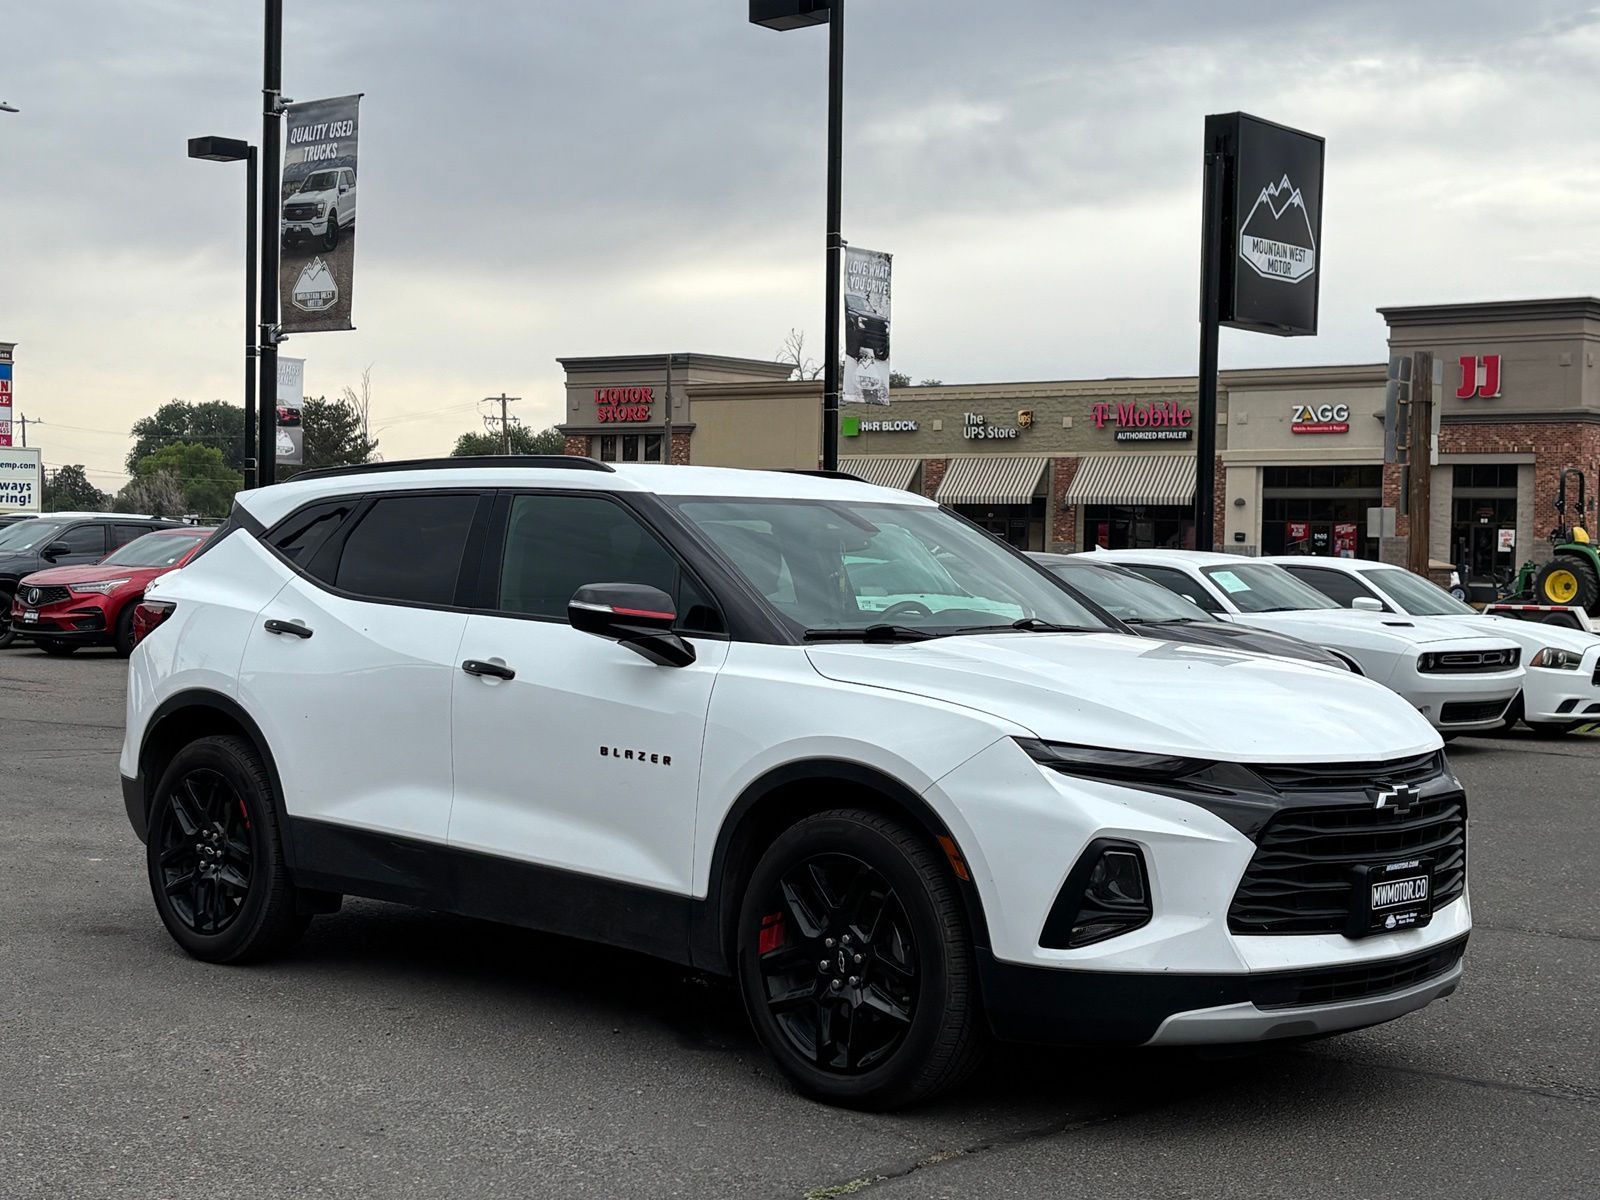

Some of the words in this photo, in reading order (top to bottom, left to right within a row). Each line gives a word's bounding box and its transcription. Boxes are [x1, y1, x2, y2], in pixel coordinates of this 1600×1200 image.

[291, 123, 328, 144] QUALITY
[329, 120, 353, 138] USED
[304, 142, 338, 162] TRUCKS
[1252, 238, 1288, 259] MOUNTAIN
[1289, 247, 1306, 263] WEST
[849, 261, 868, 275] LOVE
[870, 263, 888, 279] WHAT
[1268, 258, 1292, 275] MOTOR
[850, 275, 866, 290] YOU
[593, 386, 653, 406] LIQUOR
[597, 405, 649, 423] STORE
[963, 412, 984, 425] The
[1090, 401, 1192, 429] T-Mobile
[1292, 404, 1349, 422] ZAGG
[861, 421, 880, 431] H&R
[882, 420, 917, 431] BLOCK
[963, 426, 985, 439] UPS
[987, 426, 1016, 438] Store
[1117, 432, 1157, 440] AUTHORIZED
[1158, 431, 1187, 439] RETAILER
[600, 745, 672, 766] BLAZER
[1373, 878, 1426, 906] MWMOTOR.CO
